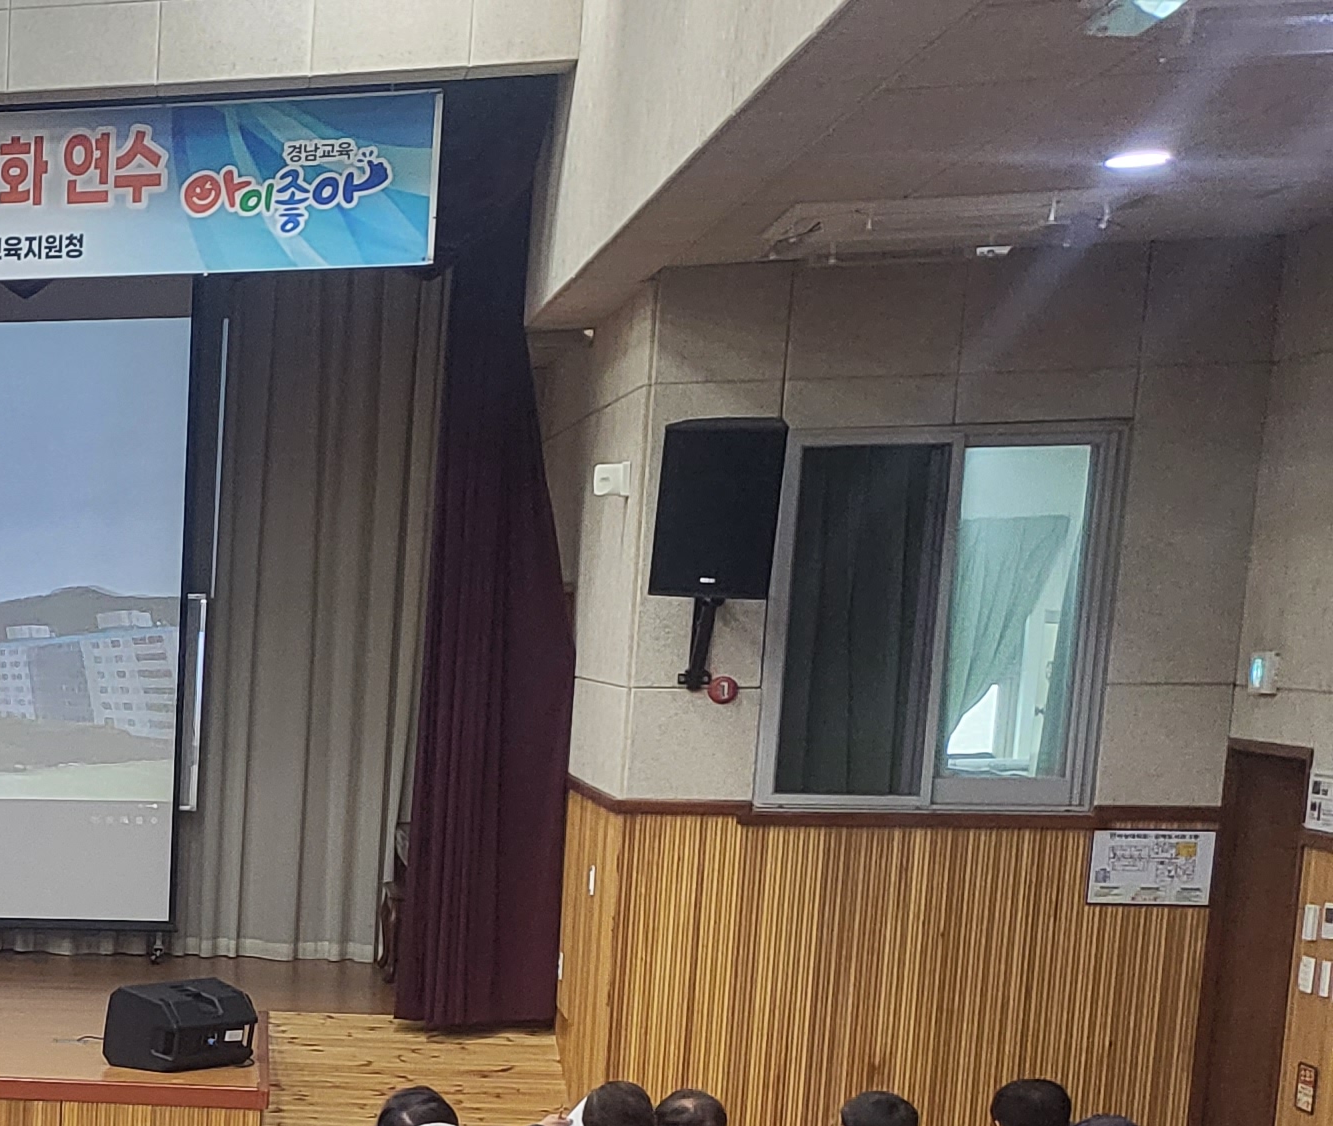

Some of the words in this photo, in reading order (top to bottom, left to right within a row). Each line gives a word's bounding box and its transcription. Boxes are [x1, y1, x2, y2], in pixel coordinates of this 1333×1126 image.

[63, 130, 163, 205] 연수
[287, 142, 354, 163] 경남교육
[184, 160, 389, 233] 아이좋아
